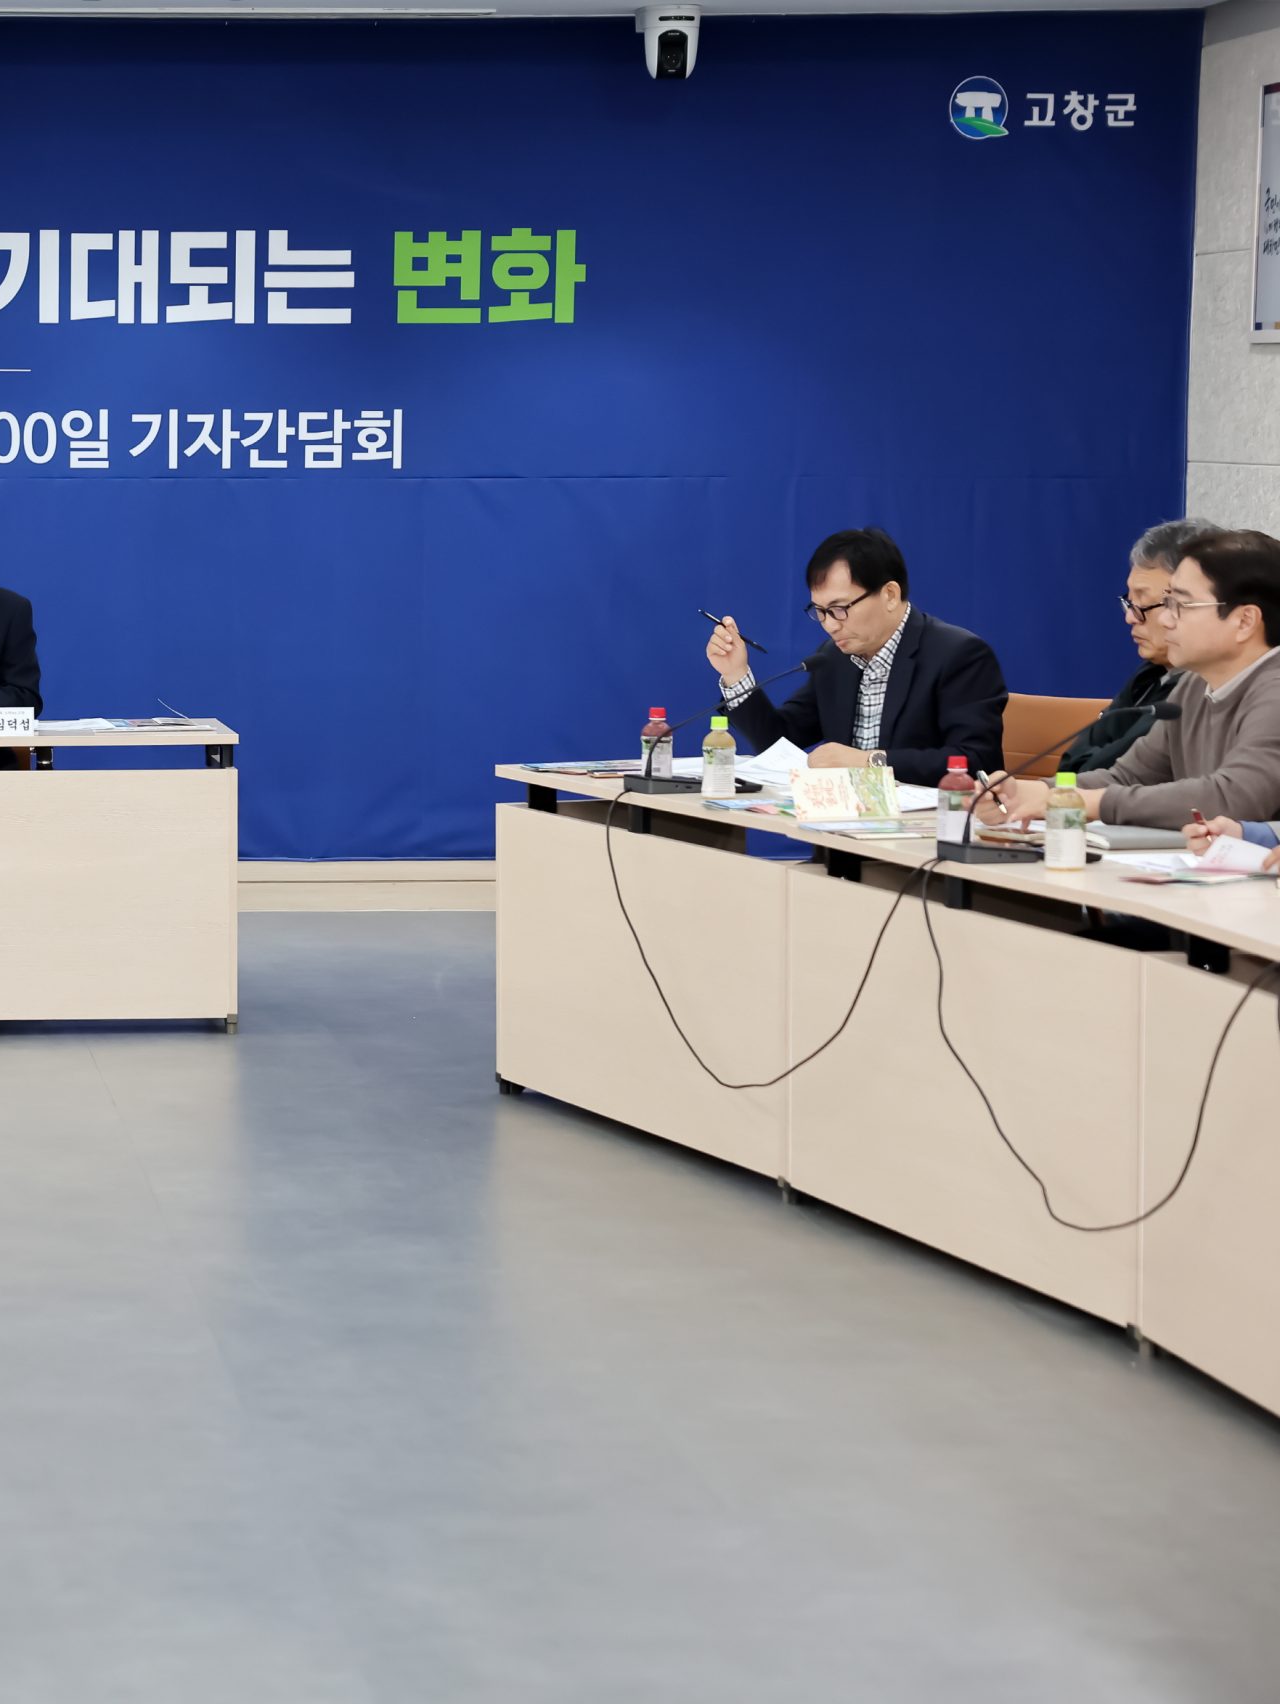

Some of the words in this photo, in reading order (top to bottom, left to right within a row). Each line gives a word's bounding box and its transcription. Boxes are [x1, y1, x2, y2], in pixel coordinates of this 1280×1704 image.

[1024, 91, 1137, 131] 고창군
[392, 227, 587, 324] 변화
[129, 408, 404, 470] 기자간담회
